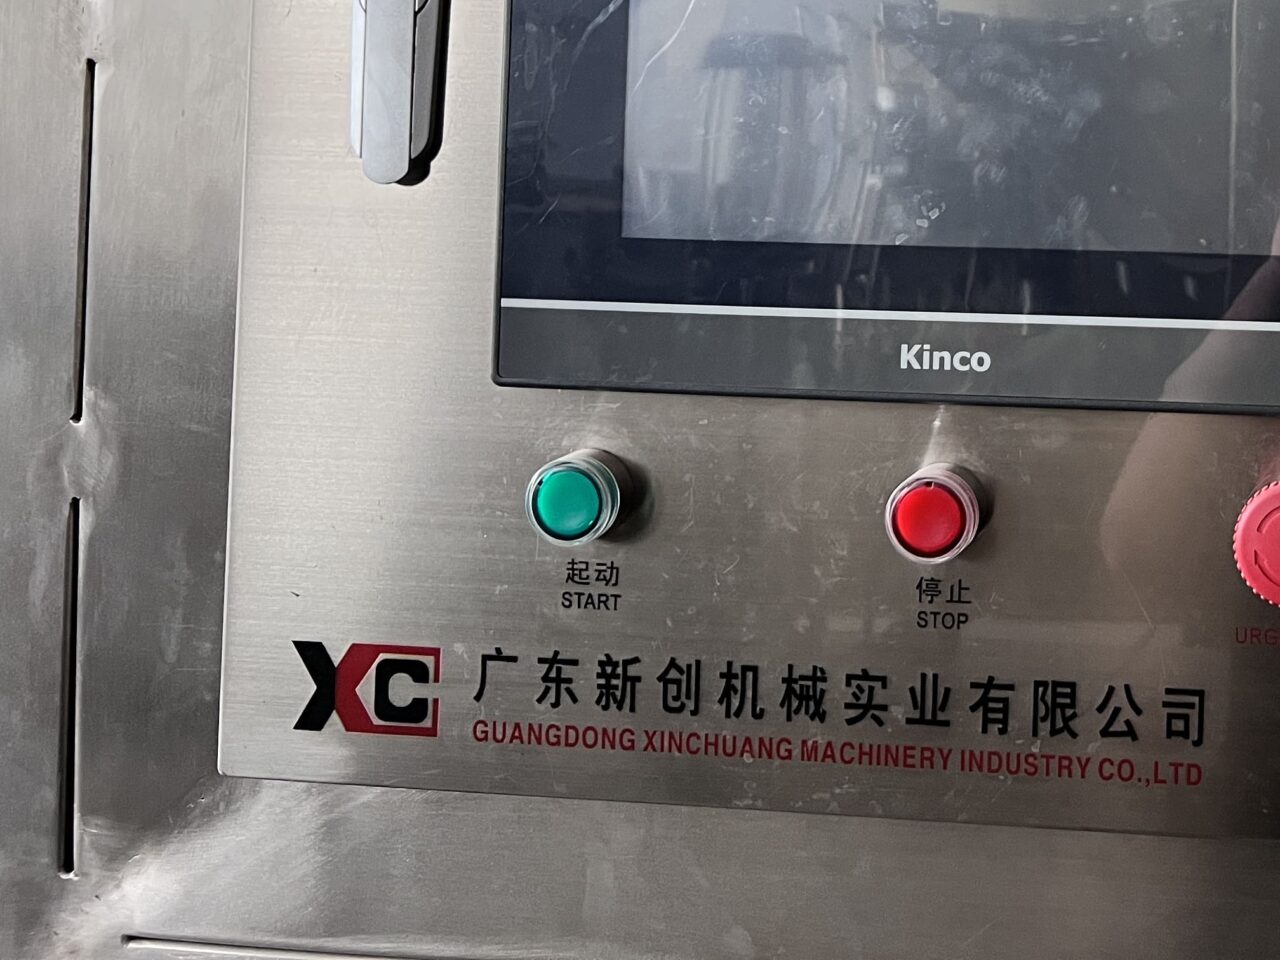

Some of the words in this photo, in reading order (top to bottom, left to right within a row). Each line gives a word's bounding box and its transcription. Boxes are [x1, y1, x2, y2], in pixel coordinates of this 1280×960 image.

[900, 344, 992, 372] Kinco
[565, 558, 620, 587] 起动
[561, 592, 622, 611] START
[915, 576, 973, 605] 停止
[916, 611, 969, 630] STOP
[472, 646, 1207, 748] 广东新创机械实业有限公司
[472, 719, 636, 751] GUANGDONG
[642, 729, 793, 761] XINCHUANG
[800, 739, 952, 771] MACHINERY
[960, 749, 1091, 779] INDUSTRY
[1098, 757, 1203, 789] CO.,LTD
